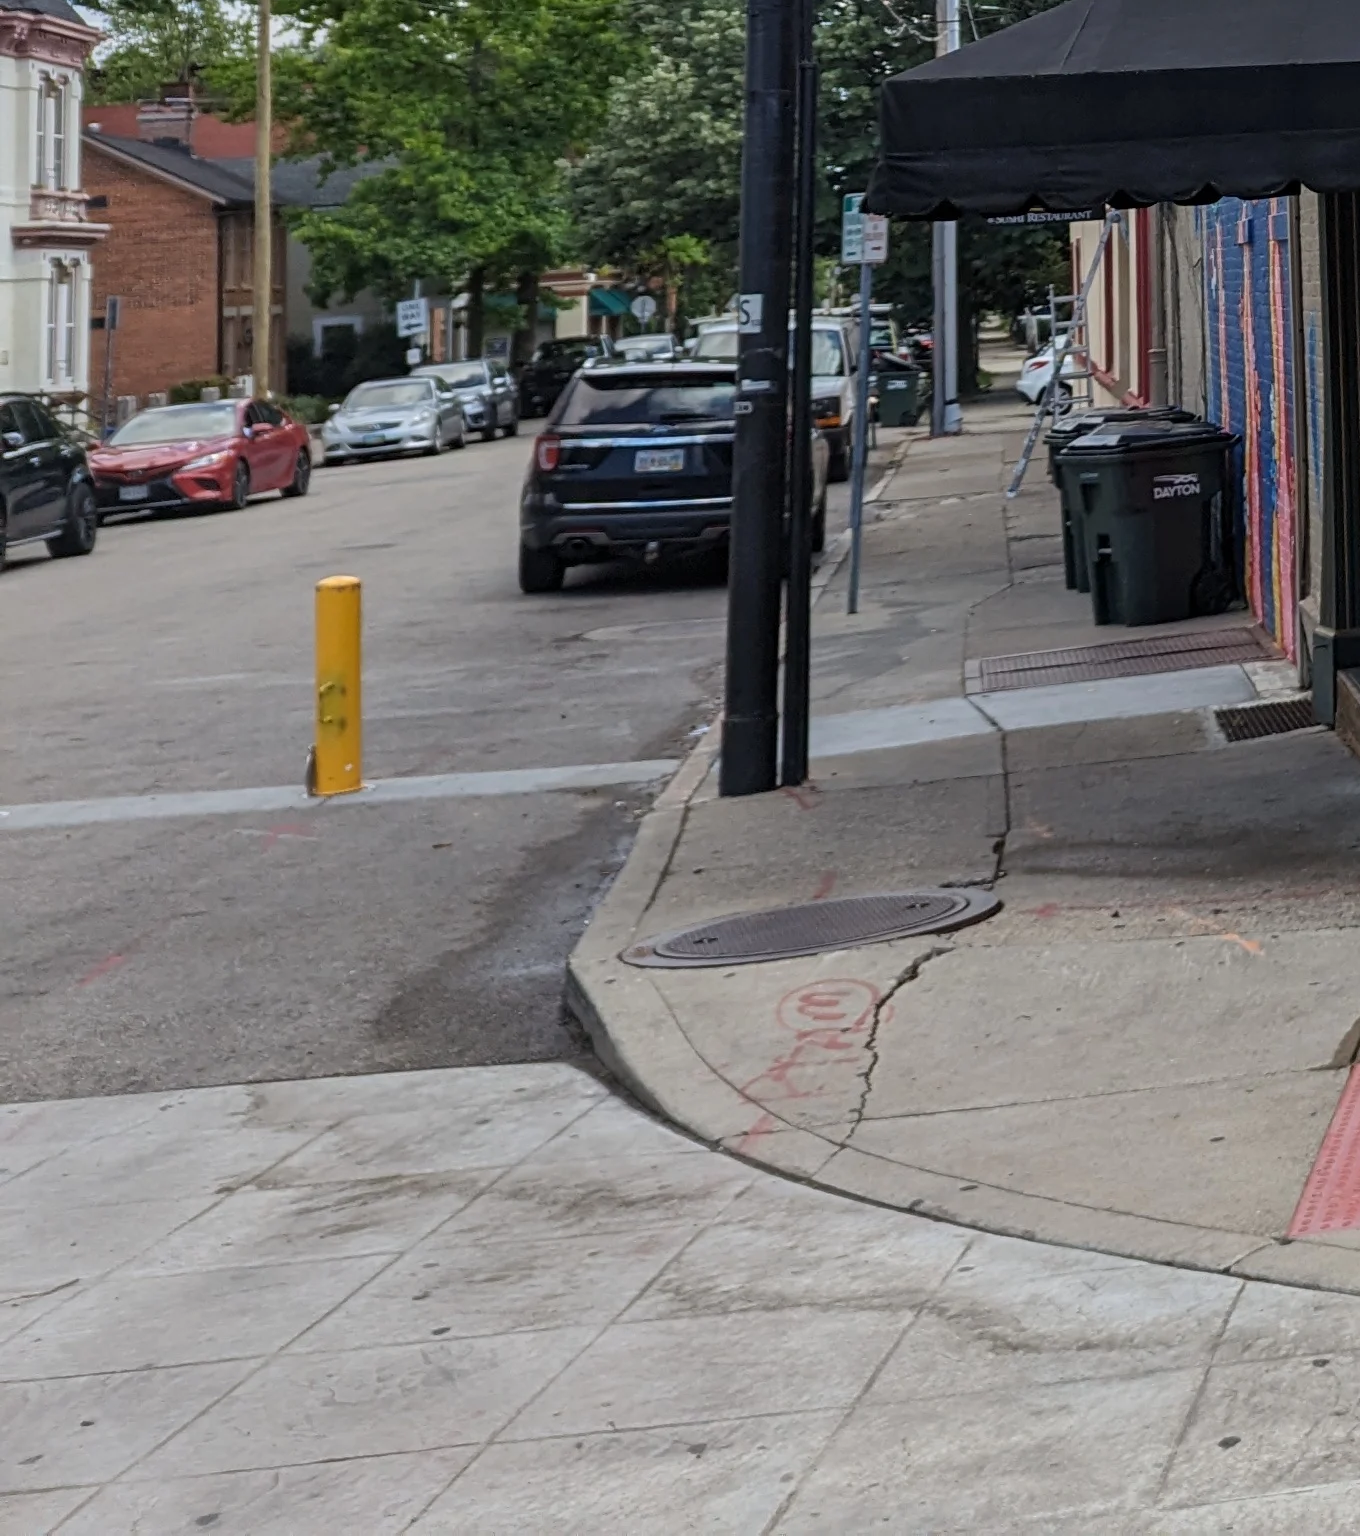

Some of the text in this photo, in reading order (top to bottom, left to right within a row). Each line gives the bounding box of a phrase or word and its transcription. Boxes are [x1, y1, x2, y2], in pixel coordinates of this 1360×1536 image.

[995, 214, 1025, 225] SUSHI
[1026, 209, 1093, 224] RESTAURANT
[1152, 483, 1201, 500] DAYTON
